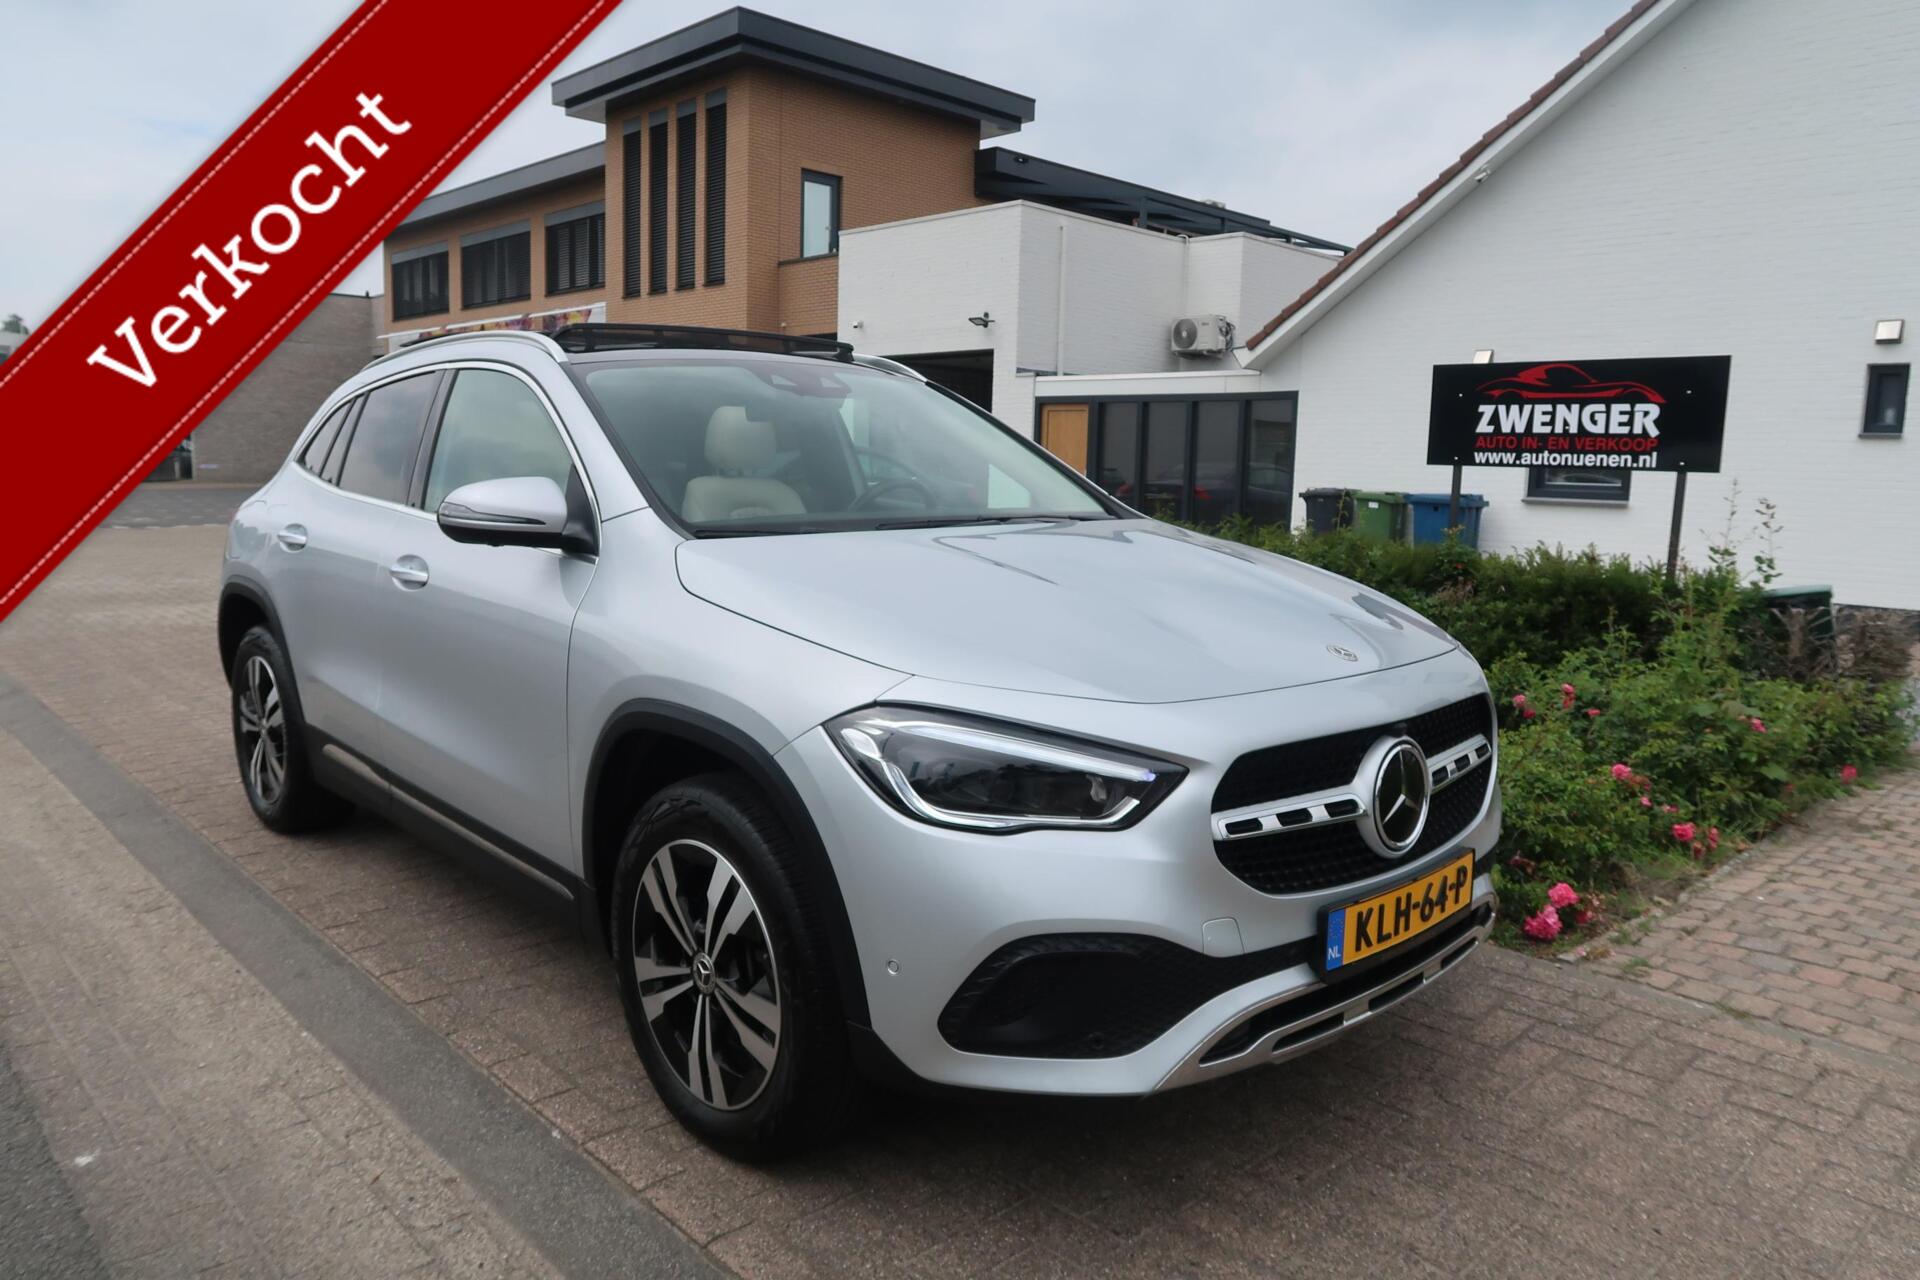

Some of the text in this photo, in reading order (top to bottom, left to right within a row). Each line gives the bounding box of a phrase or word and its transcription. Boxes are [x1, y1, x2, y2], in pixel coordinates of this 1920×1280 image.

[1475, 403, 1661, 438] ZWENGER
[1475, 436, 1659, 451] AUTO IN- EN VERKOOP
[1474, 450, 1658, 468] www.autonuenen.nl
[1355, 865, 1468, 952] KLH-64-P
[1328, 946, 1342, 961] NL
